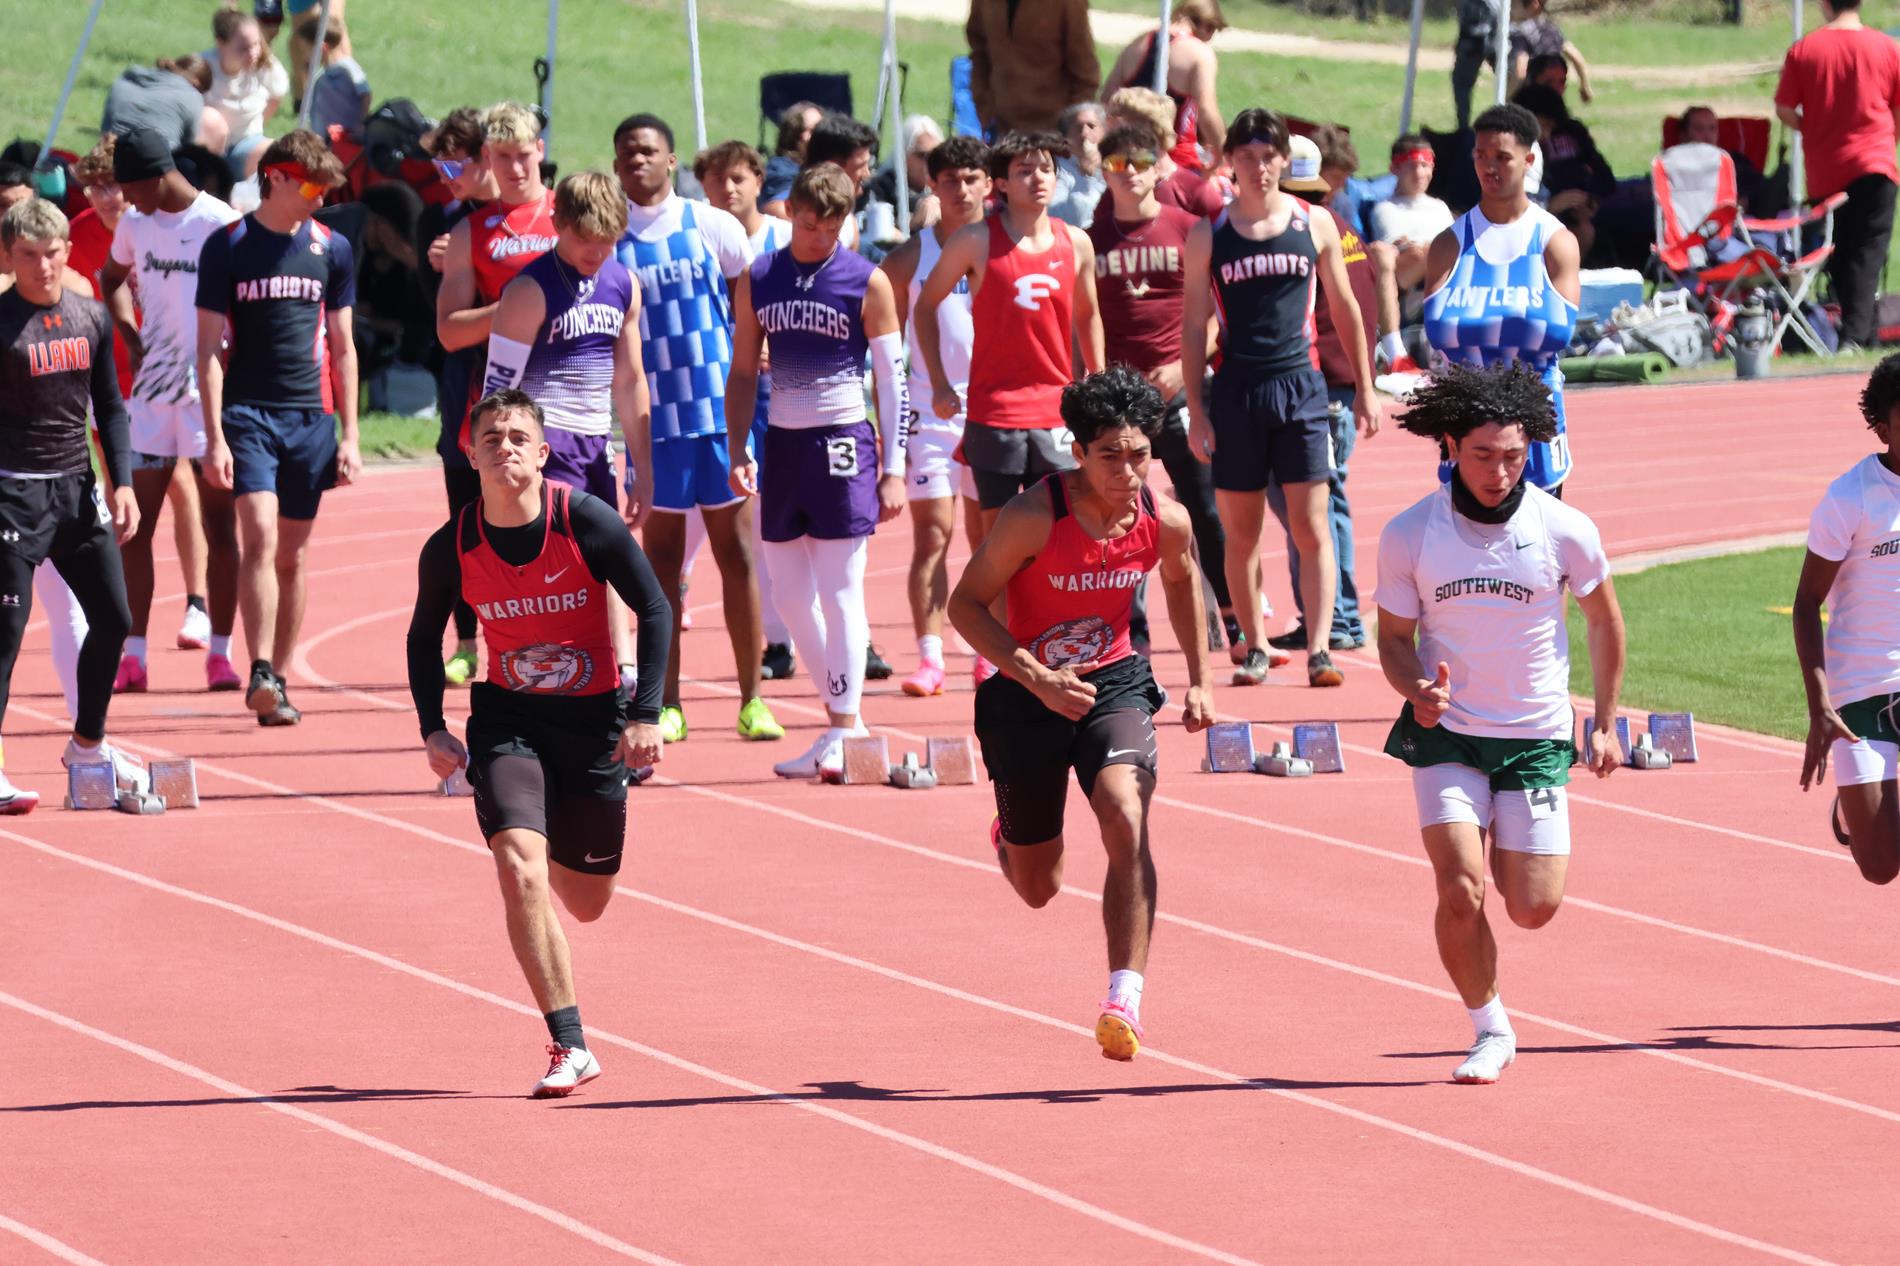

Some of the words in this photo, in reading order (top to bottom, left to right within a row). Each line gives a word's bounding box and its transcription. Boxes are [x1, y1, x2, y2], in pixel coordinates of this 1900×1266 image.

[143, 250, 197, 279] Dragons
[1221, 253, 1309, 285] PATRIOTS
[236, 275, 322, 301] PATRIOTS
[1446, 285, 1544, 308] ANTLERS
[757, 300, 850, 340] PUNCHERS
[27, 336, 91, 377] LLANO
[832, 441, 855, 470] 3
[1554, 438, 1562, 467] 1
[477, 588, 588, 620] WARRIORS
[1435, 577, 1534, 604] SOUTHWEST
[1529, 787, 1558, 812] 4
